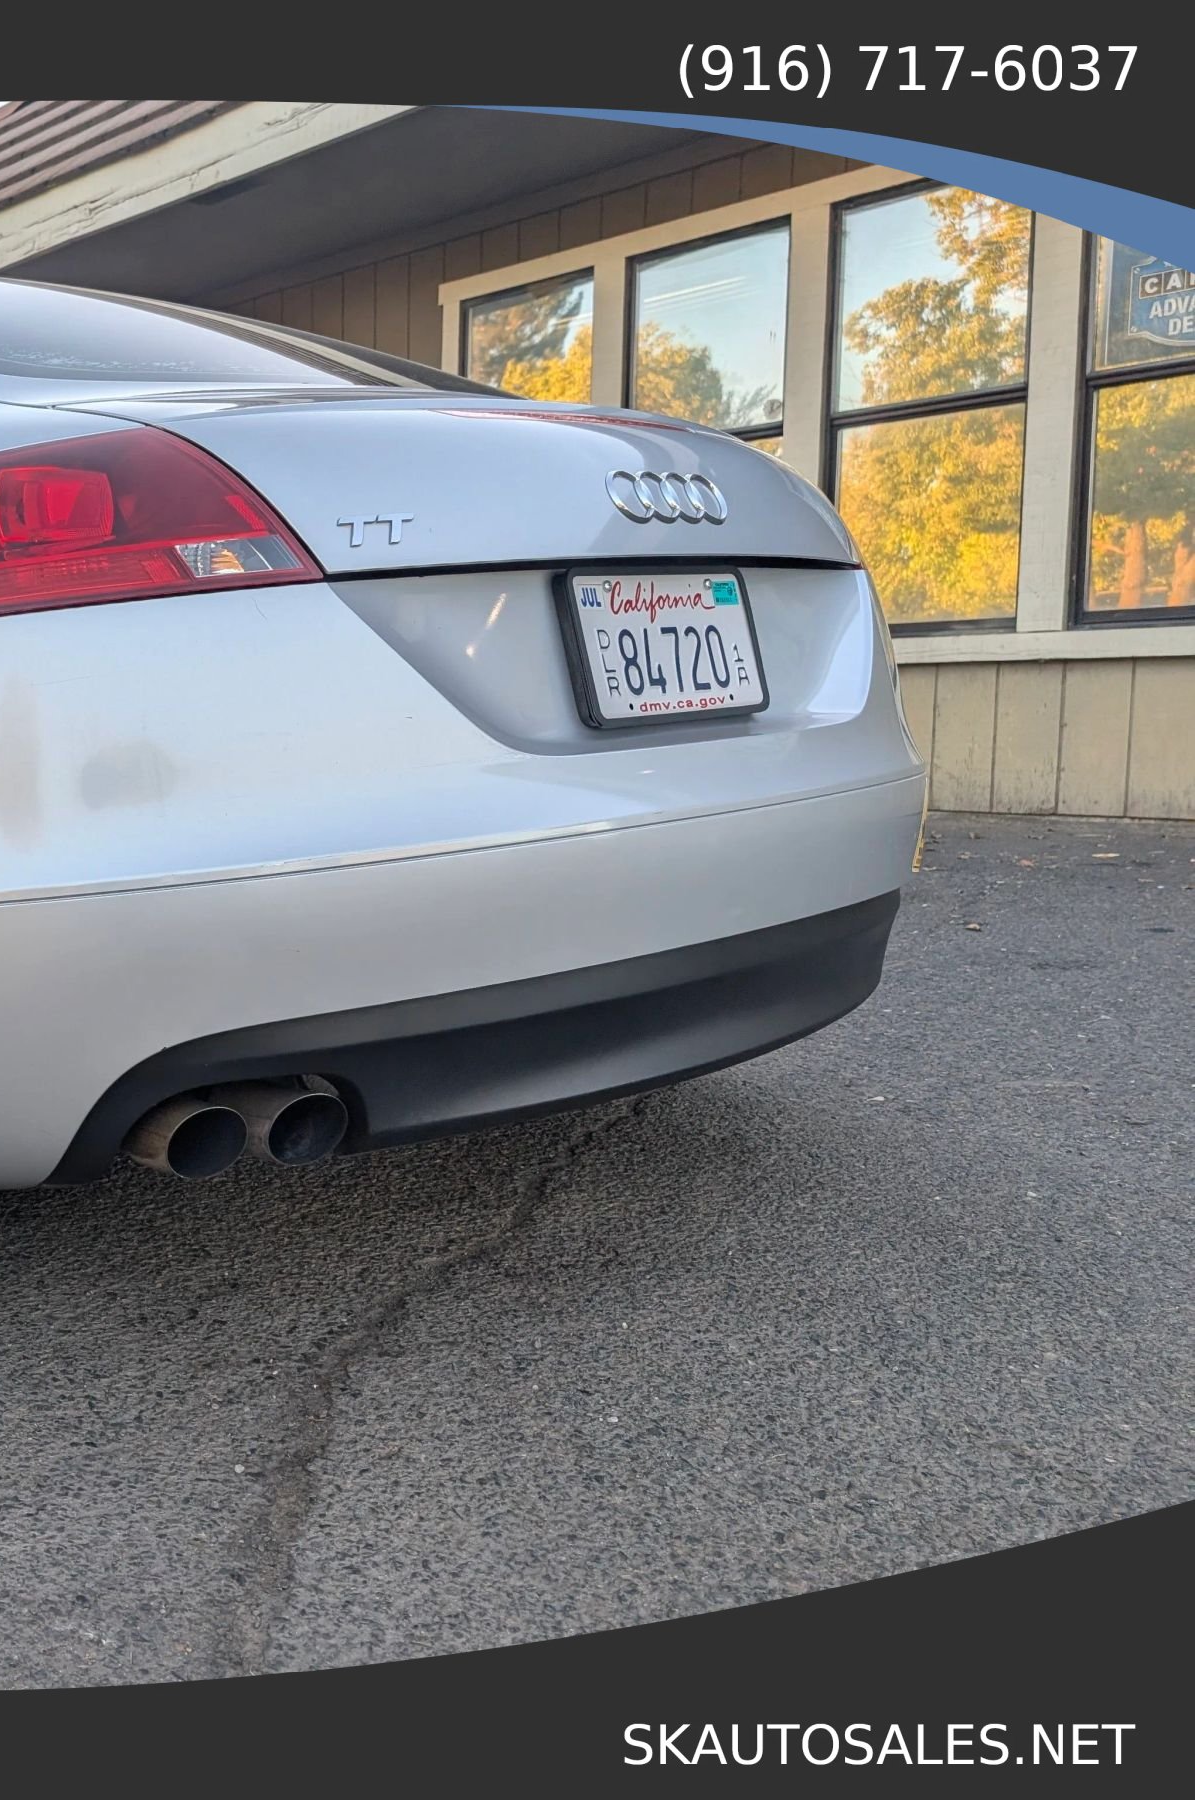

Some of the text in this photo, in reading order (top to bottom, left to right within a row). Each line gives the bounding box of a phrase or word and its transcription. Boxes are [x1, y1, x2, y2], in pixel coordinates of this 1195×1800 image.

[336, 512, 415, 548] TT
[580, 587, 602, 608] JUL
[610, 581, 716, 624] California
[618, 625, 730, 695] 84720
[640, 696, 726, 714] dmv.ca.gov
